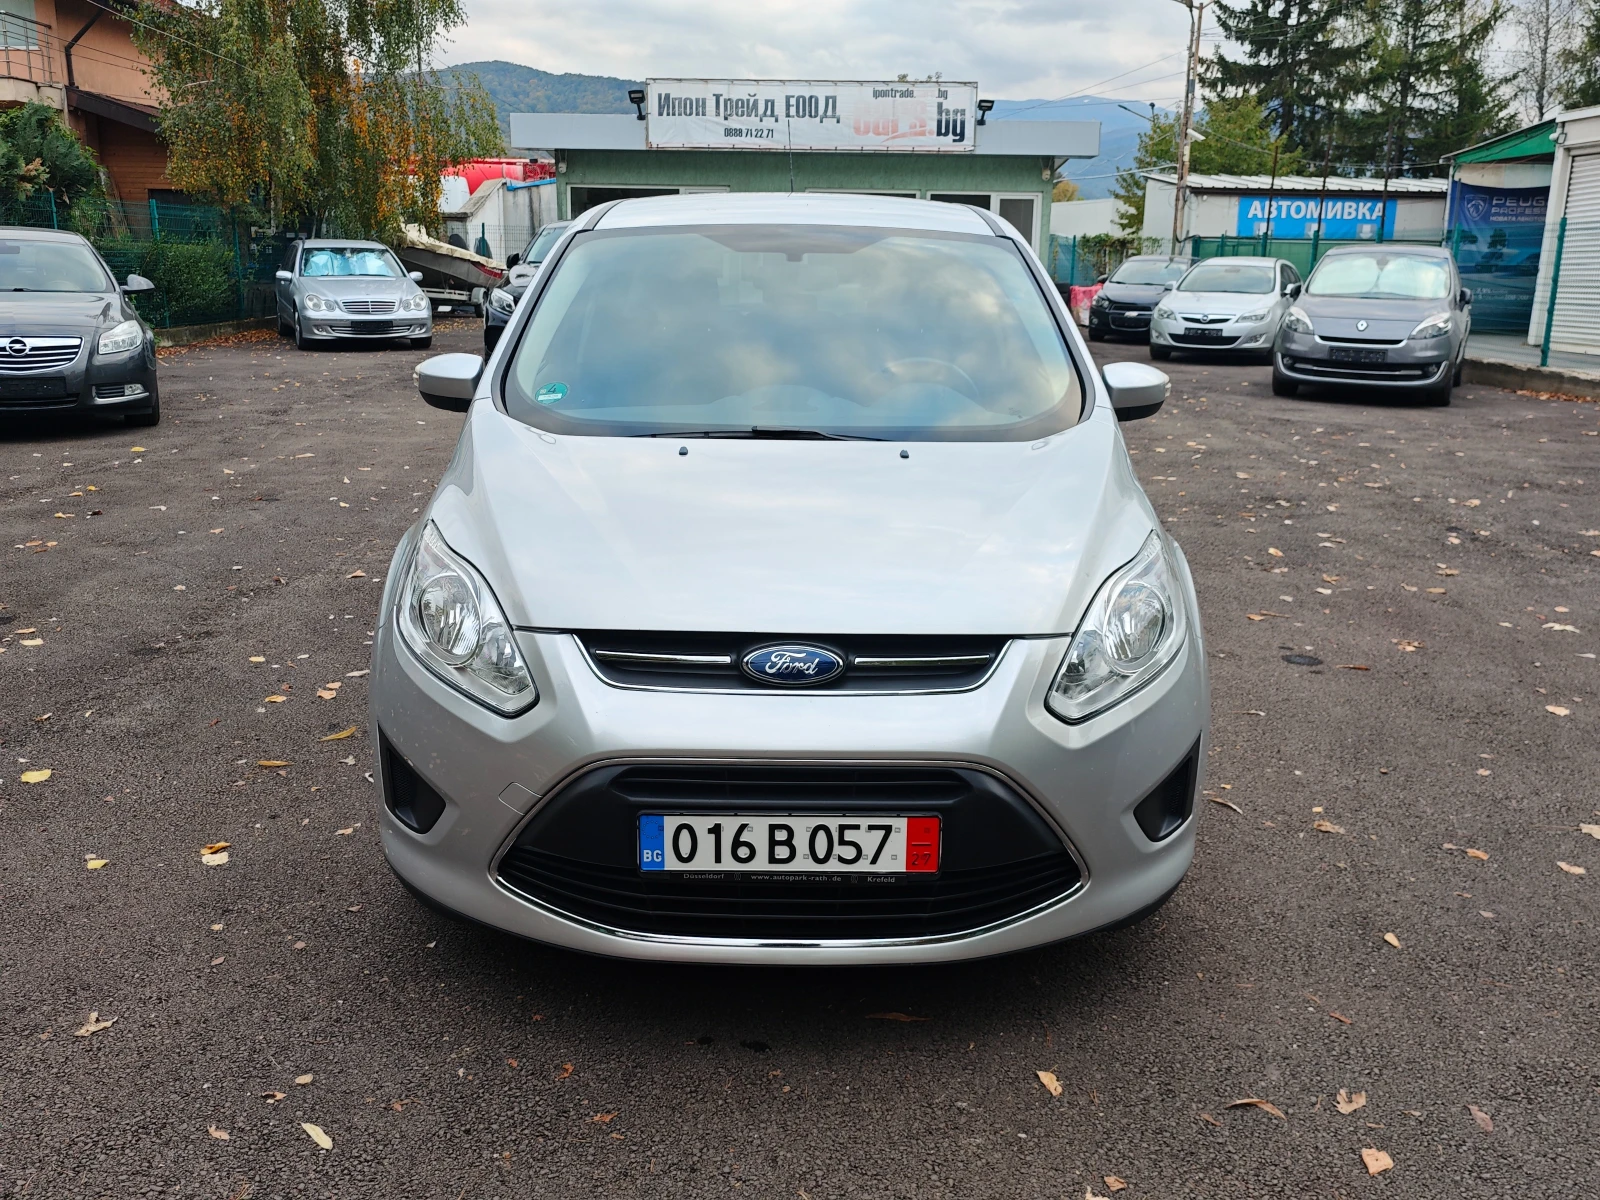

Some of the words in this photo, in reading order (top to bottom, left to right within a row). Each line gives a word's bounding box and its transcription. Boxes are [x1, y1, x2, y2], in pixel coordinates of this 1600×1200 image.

[657, 92, 707, 117] Ипон
[712, 92, 779, 123] Трейд
[784, 94, 841, 124] ЕООД
[724, 127, 743, 138] 0888
[744, 128, 753, 139] 71
[754, 128, 764, 139] 22
[765, 128, 774, 139] 71
[1247, 200, 1385, 221] АВТОМИВКА
[547, 383, 557, 394] 4
[764, 651, 820, 675] Ford
[643, 849, 662, 863] BG
[911, 852, 931, 867] 27
[683, 872, 725, 880] Düsseldorf
[750, 874, 842, 883] www.autopark-rath.de
[867, 875, 896, 883] Krefeld
